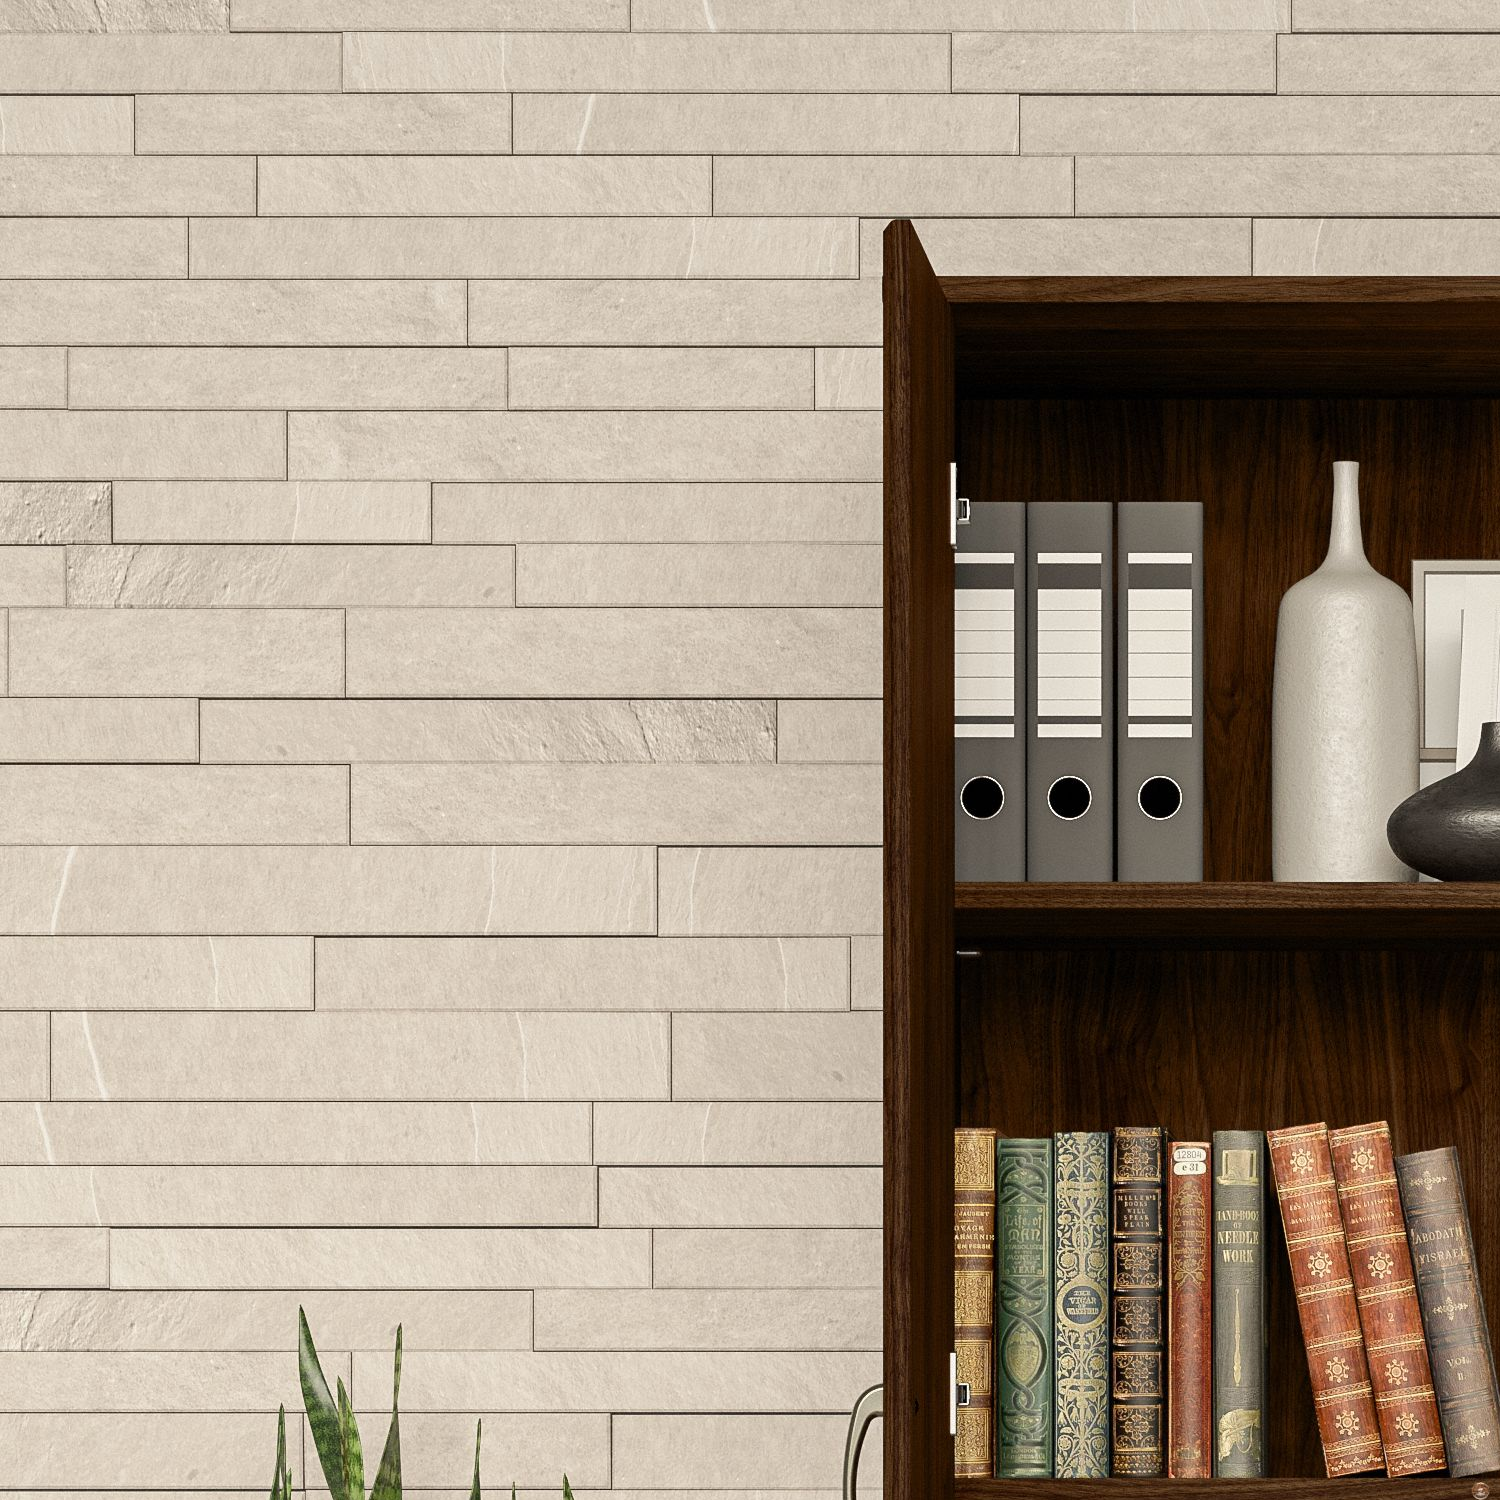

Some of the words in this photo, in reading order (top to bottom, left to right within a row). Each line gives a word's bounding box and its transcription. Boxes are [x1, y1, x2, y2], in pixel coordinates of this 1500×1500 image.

[1217, 1230, 1259, 1245] NEEDLE
[1222, 1249, 1254, 1263] WORK
[1387, 1312, 1395, 1322] 2
